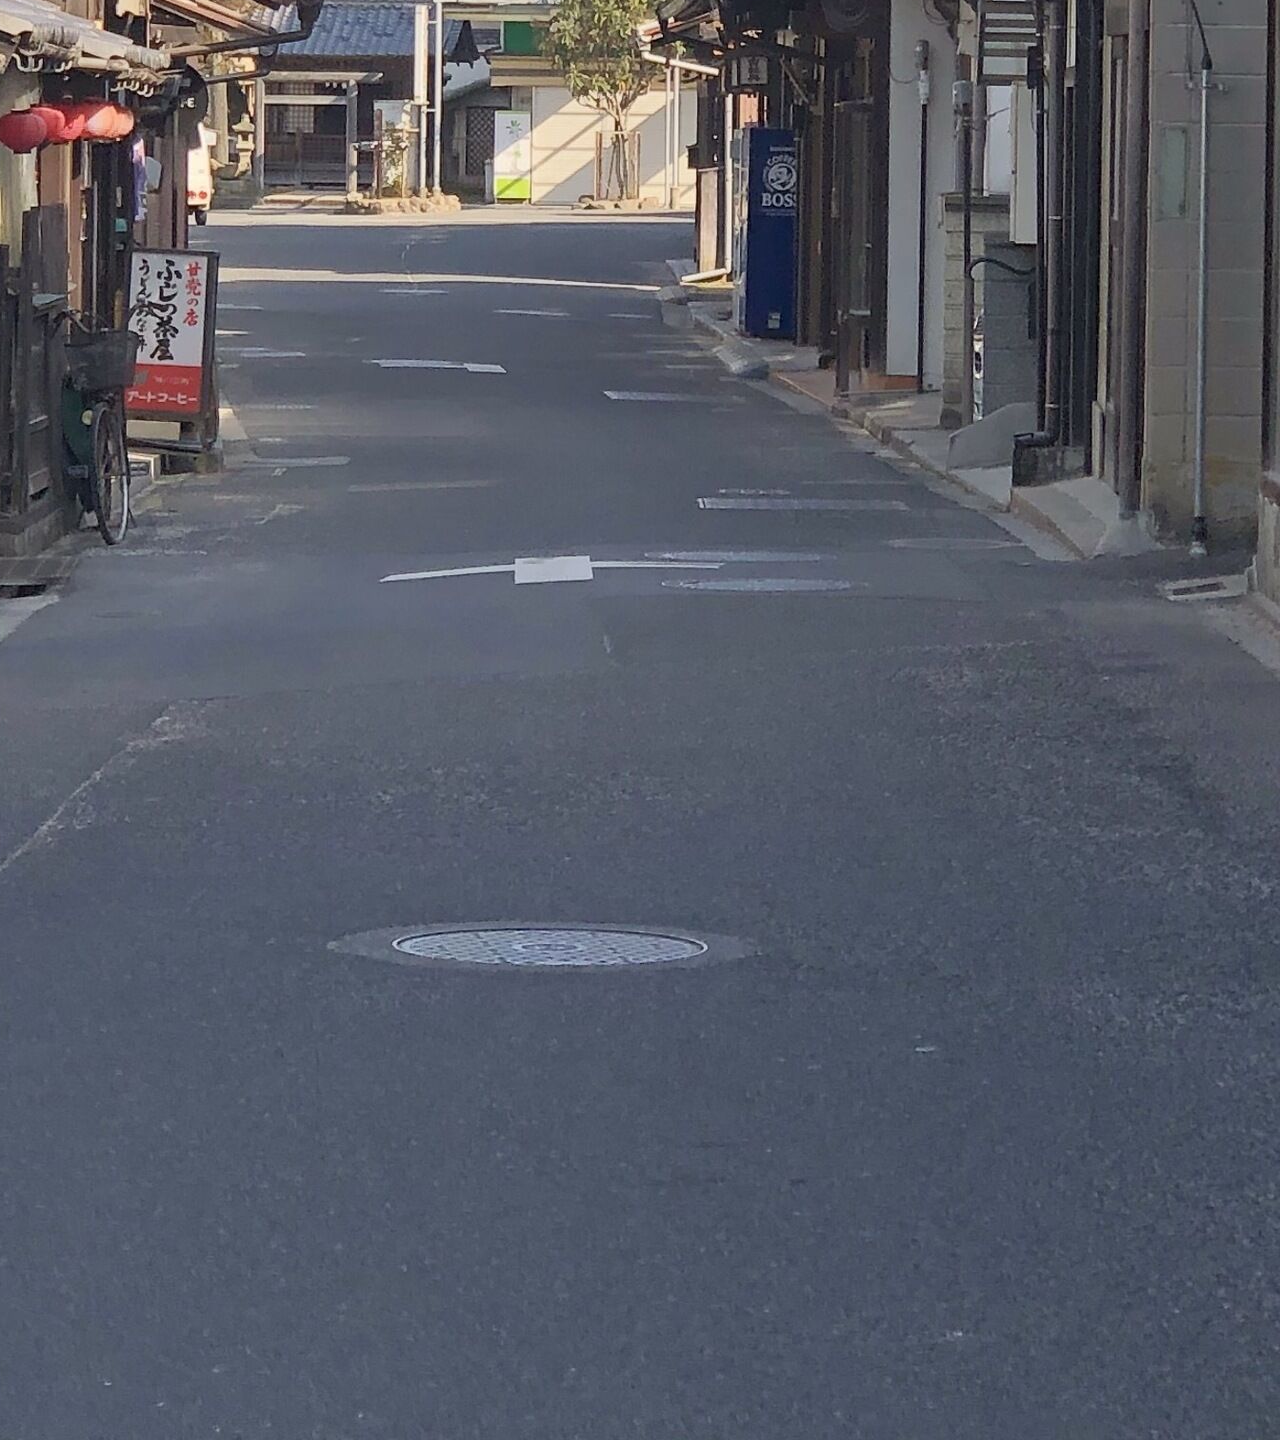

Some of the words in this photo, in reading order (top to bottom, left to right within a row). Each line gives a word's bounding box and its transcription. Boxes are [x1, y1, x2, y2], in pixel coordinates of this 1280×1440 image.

[127, 390, 198, 405] アートコーヒー
